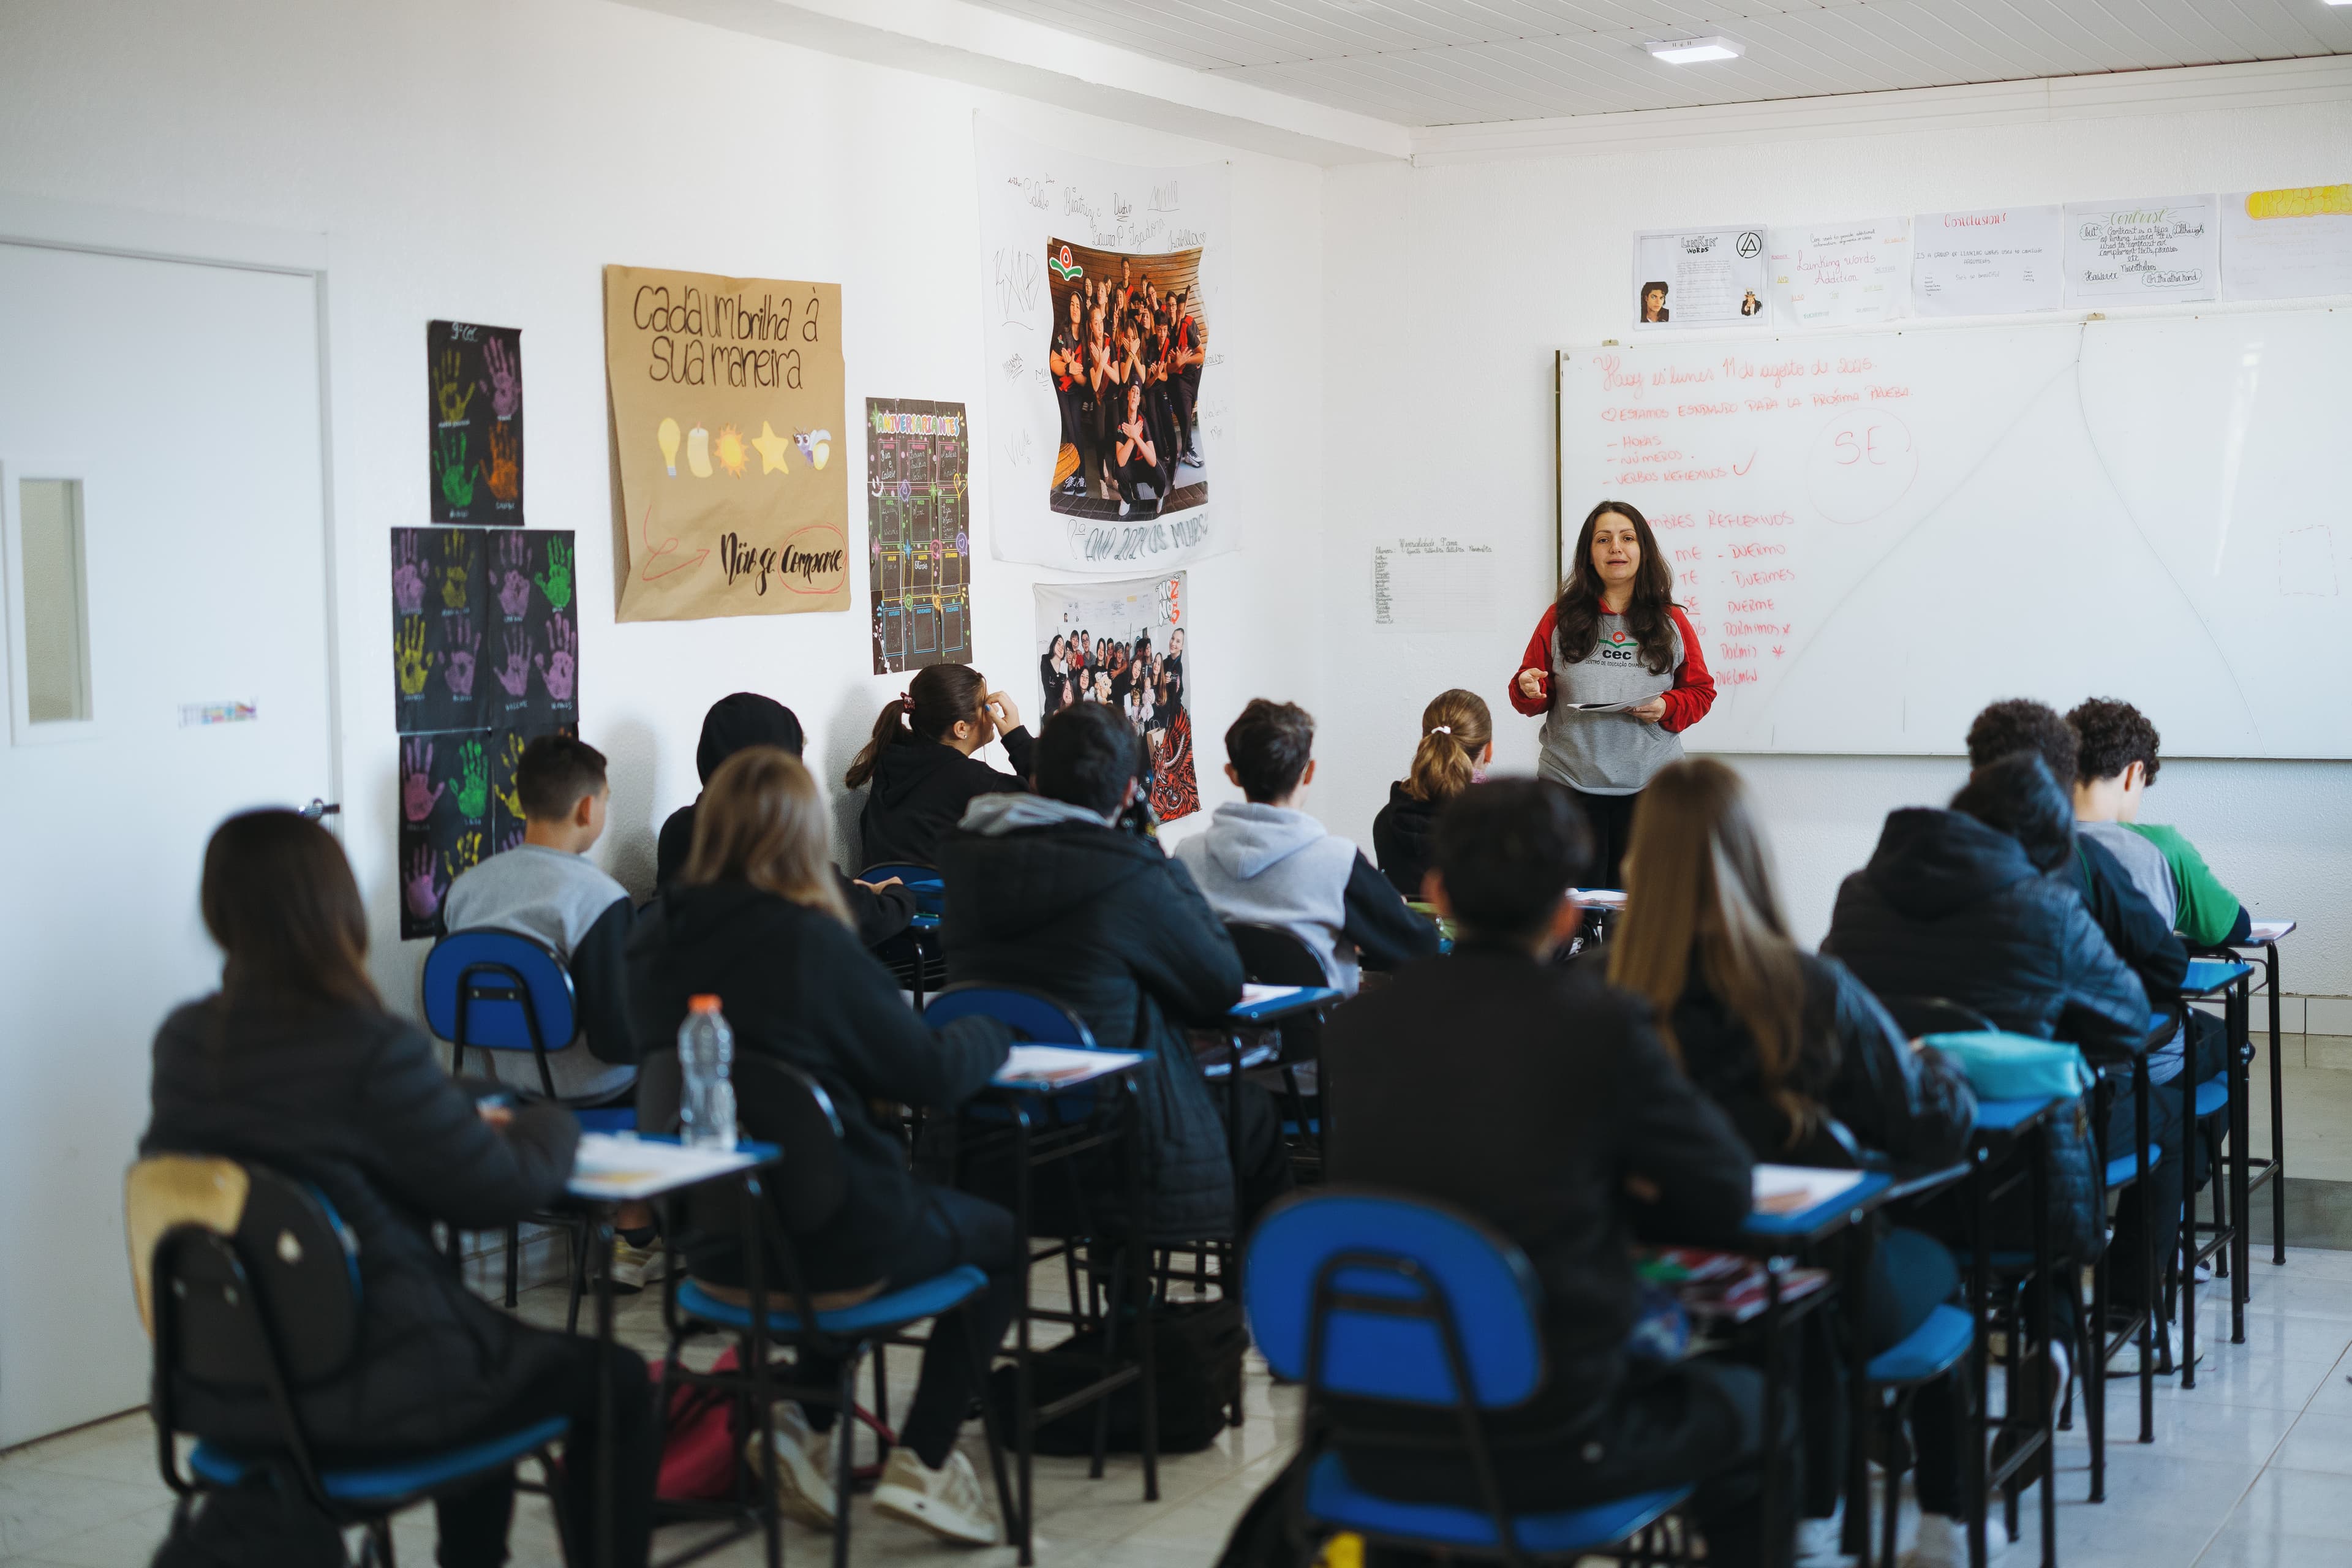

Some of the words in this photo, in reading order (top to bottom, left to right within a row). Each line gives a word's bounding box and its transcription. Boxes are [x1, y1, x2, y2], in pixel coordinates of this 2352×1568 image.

[634, 285, 703, 337] Cada
[705, 293, 734, 339] um
[738, 294, 792, 341] brilha
[712, 342, 803, 390] maneira
[1723, 357, 1735, 377] 11
[1760, 360, 1804, 388] agosto
[1745, 398, 1779, 413] PARA
[1787, 398, 1803, 409] LA
[876, 413, 960, 437] ANIVERSARIANTES
[1835, 426, 1887, 465] SE
[1615, 472, 1659, 486] VERBOS
[1708, 510, 1795, 530] REFLEXIVOS
[1676, 546, 1702, 562] ME
[1728, 543, 1786, 559] DUERMO
[1679, 570, 1699, 586] TE
[1732, 568, 1795, 589] DUERMES
[1683, 596, 1700, 611] SE
[1727, 599, 1775, 615] DUERME
